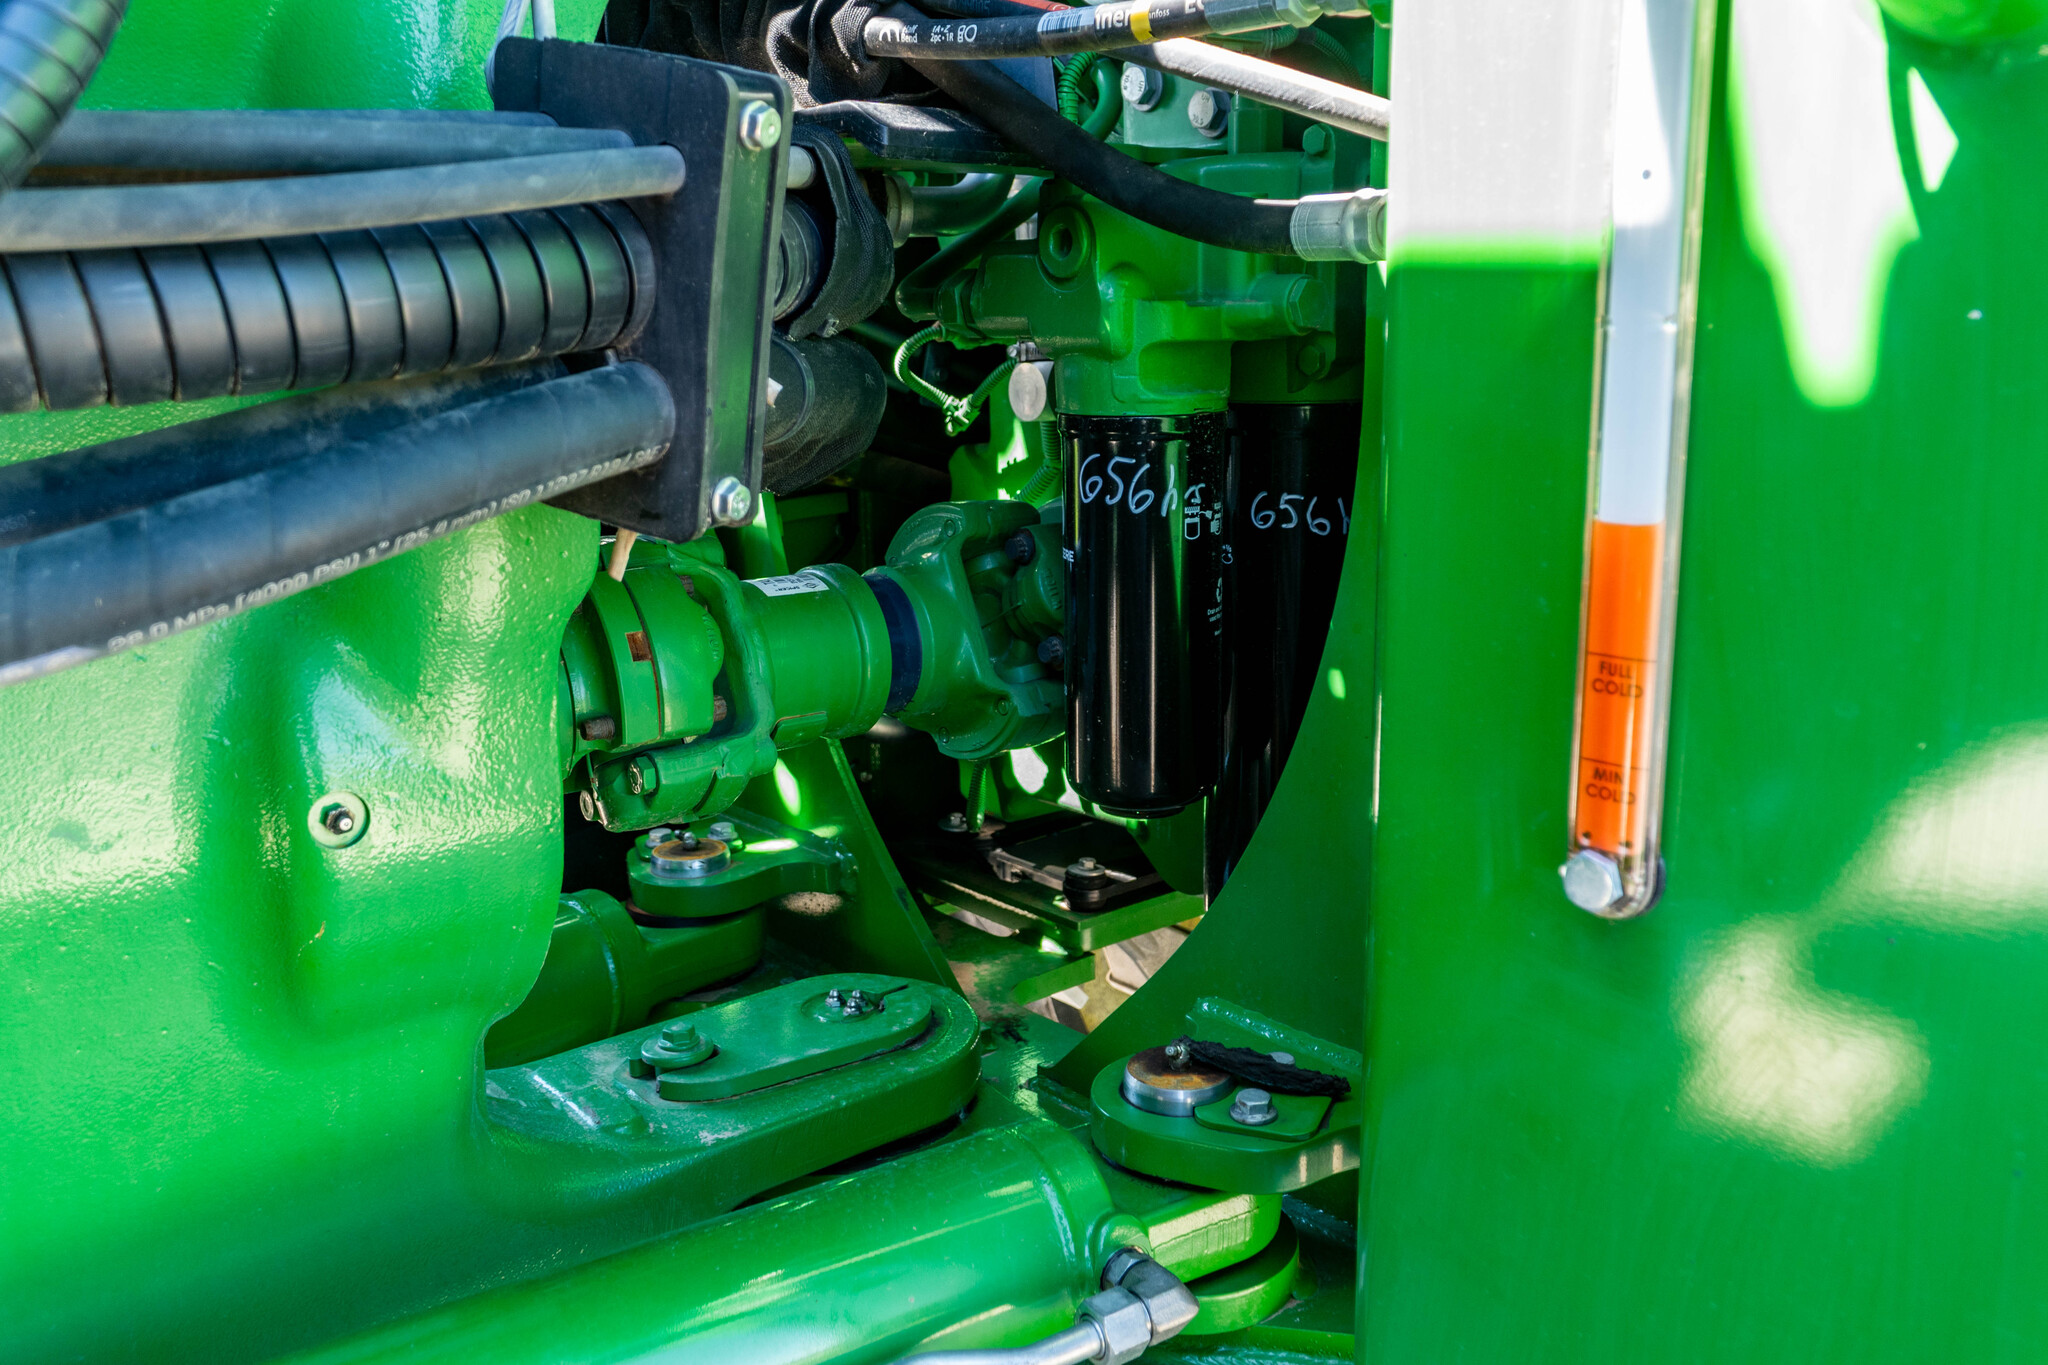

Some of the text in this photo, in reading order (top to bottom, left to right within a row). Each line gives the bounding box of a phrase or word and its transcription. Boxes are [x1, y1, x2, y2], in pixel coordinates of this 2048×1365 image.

[1079, 453, 1155, 515] 656
[1250, 490, 1332, 537] 656
[173, 602, 230, 629] MPa
[1599, 661, 1633, 679] FULL
[1591, 678, 1643, 698] COLD
[1593, 767, 1623, 784] MIN
[1585, 783, 1636, 805] COLD
